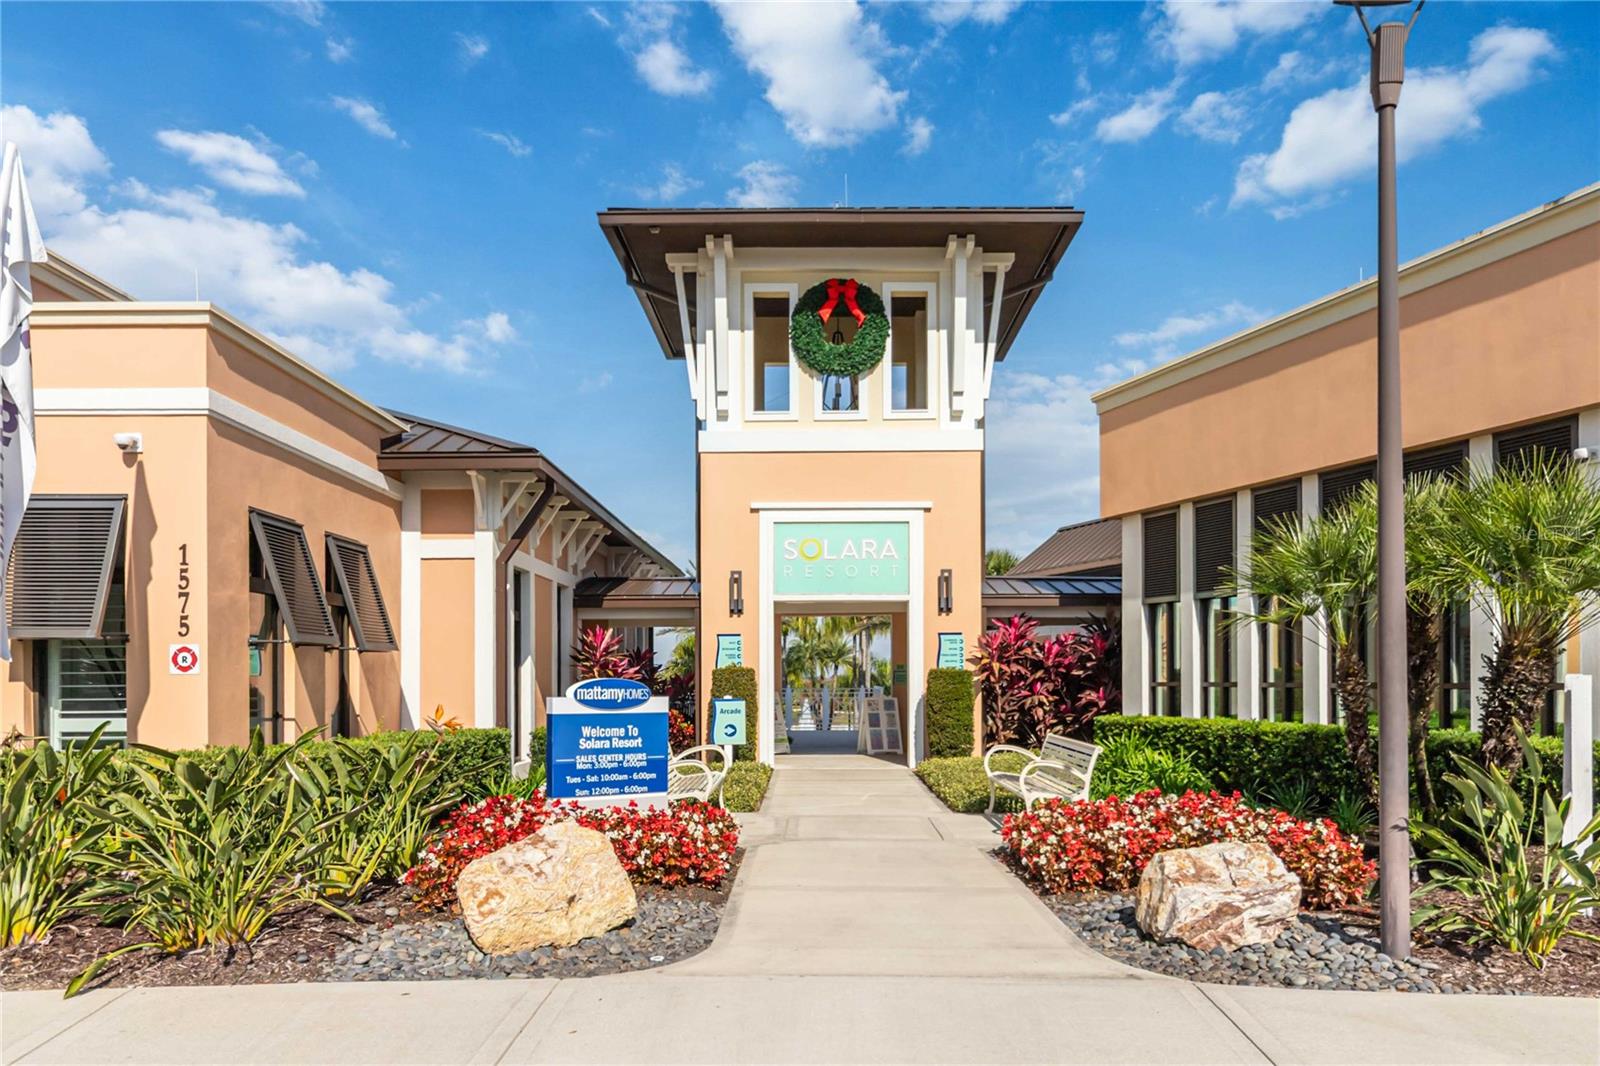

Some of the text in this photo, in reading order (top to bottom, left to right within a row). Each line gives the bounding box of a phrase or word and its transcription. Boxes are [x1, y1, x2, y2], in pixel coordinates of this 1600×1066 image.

[783, 537, 899, 561] SOLARA
[783, 564, 899, 578] RESORT
[178, 543, 190, 638] 1575
[181, 655, 188, 664] R
[720, 707, 742, 715] Arcade
[581, 724, 639, 738] Welcome To
[579, 736, 643, 750] Solara Resort
[575, 752, 647, 763] SALES CENTER HOURS
[576, 760, 593, 770] Mon:
[593, 760, 619, 769] 3:00pm
[622, 759, 648, 769] 6:00pm
[566, 775, 582, 784] Tues
[585, 774, 600, 783] Sat:
[600, 773, 629, 782] 10:00am
[632, 771, 657, 781] 6:00pm
[575, 788, 590, 797] Sun:
[591, 786, 620, 796] 12:00pm
[624, 785, 648, 795] 6:00pm
